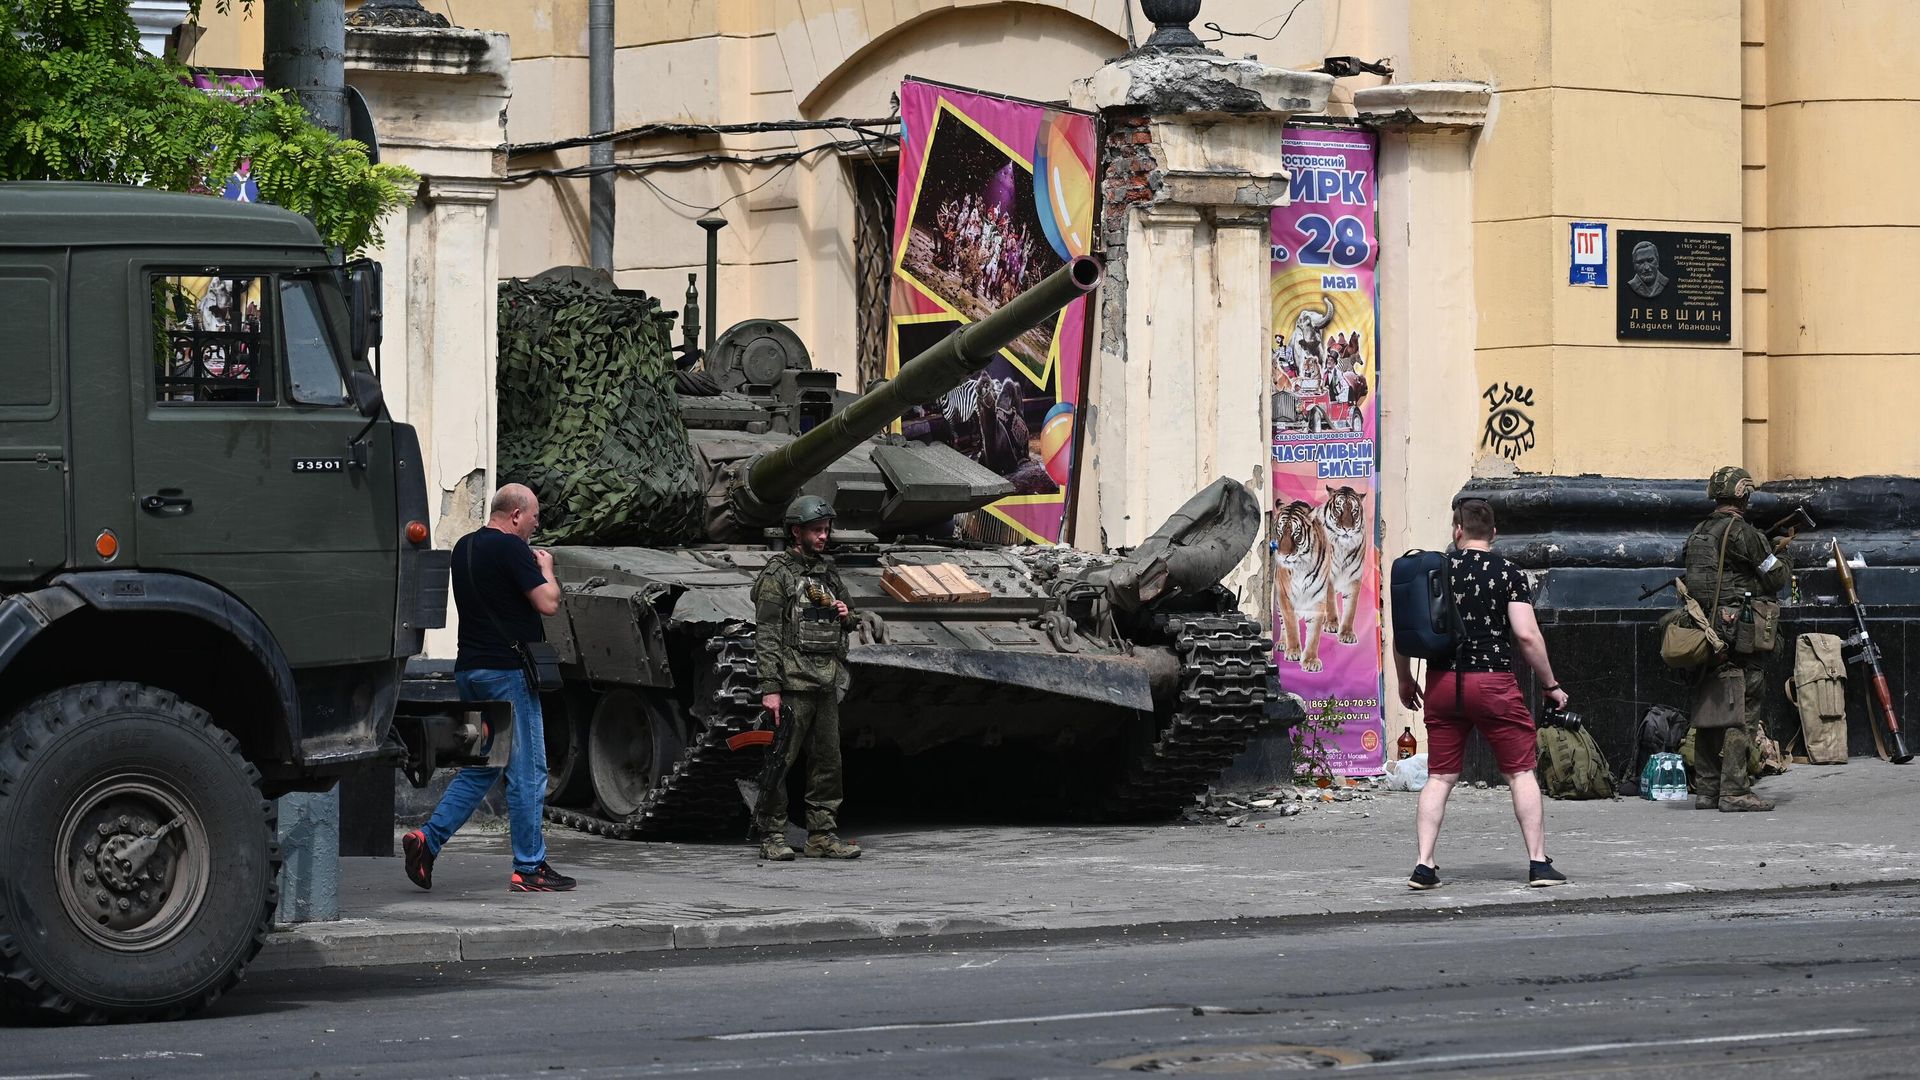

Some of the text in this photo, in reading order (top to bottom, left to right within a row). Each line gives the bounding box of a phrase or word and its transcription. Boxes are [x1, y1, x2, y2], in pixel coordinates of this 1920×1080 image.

[1289, 168, 1366, 204] ИРК
[1296, 213, 1369, 267] 28
[1577, 232, 1599, 254] ПГ
[1322, 275, 1357, 289] мая
[1630, 308, 1721, 321] ЛЕВШИН
[1629, 321, 1721, 331] Владилен Иванович
[1275, 433, 1314, 441] СКАЗОЧНОЕ
[1272, 440, 1374, 462] ЧАСТЛИВЫЙ
[296, 461, 340, 470] 53501
[1318, 460, 1374, 478] БИЛЕТ
[1309, 699, 1330, 709] (863
